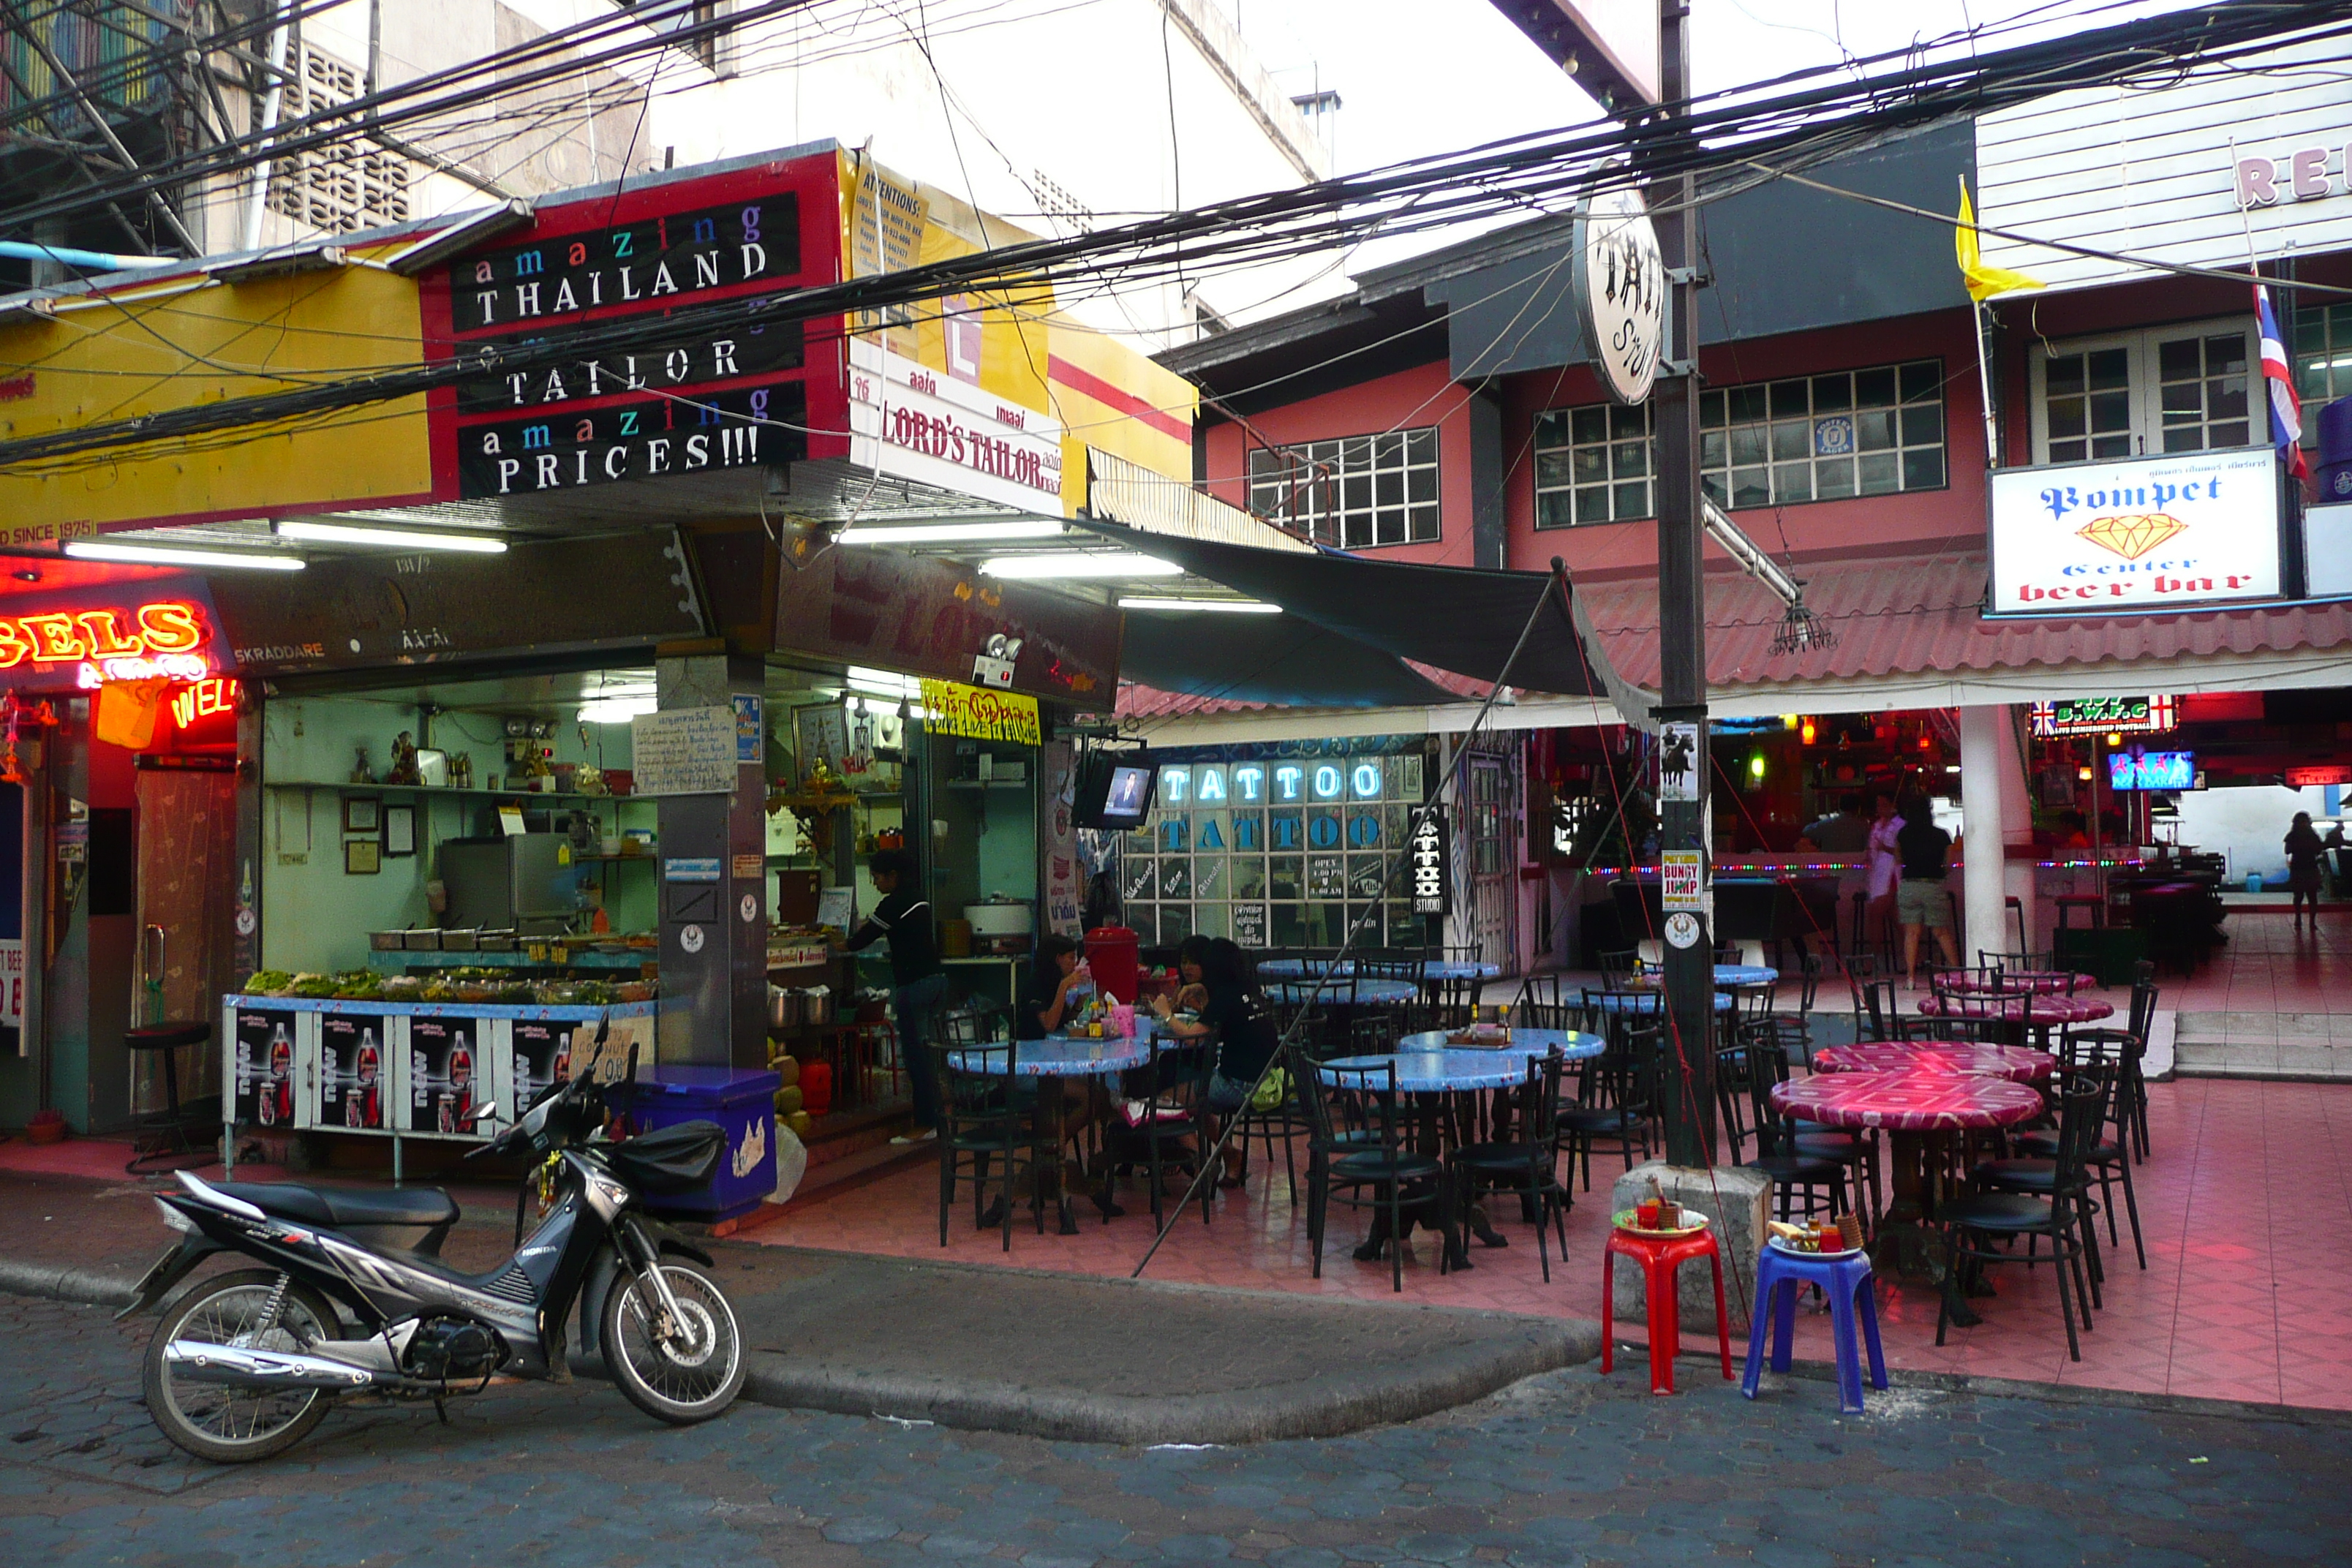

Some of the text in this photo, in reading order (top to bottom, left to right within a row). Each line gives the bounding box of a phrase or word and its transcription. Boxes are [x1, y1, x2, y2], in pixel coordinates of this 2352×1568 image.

[2234, 141, 2352, 208] RE
[475, 205, 761, 284] amazing
[477, 242, 766, 325] THAILAND
[506, 339, 739, 404] TAILOR
[483, 388, 770, 456] amazing
[1817, 419, 1852, 435] FOSTER'S
[881, 400, 1043, 489] LORD'S TAILOR
[1820, 442, 1850, 454] LAGER
[498, 425, 758, 494] PRICES!!!
[2040, 474, 2223, 521] Pompet
[12, 524, 54, 543] SINCE
[59, 520, 91, 540] 1975
[2062, 559, 2198, 577] Center
[2019, 574, 2252, 602] beer bar
[2115, 722, 2151, 731] FOOTBALL
[1164, 764, 1382, 802] TATTOO
[1161, 814, 1380, 850] TATTOO
[1315, 859, 1337, 867] OPEN
[1412, 806, 1441, 897] TATTOO
[1331, 869, 1343, 877] PM
[1665, 864, 1697, 878] BUNGY
[1330, 887, 1342, 895] AM
[1665, 880, 1697, 894] JUMP
[1416, 898, 1440, 912] STUDIO
[521, 1245, 558, 1257] HONDA
